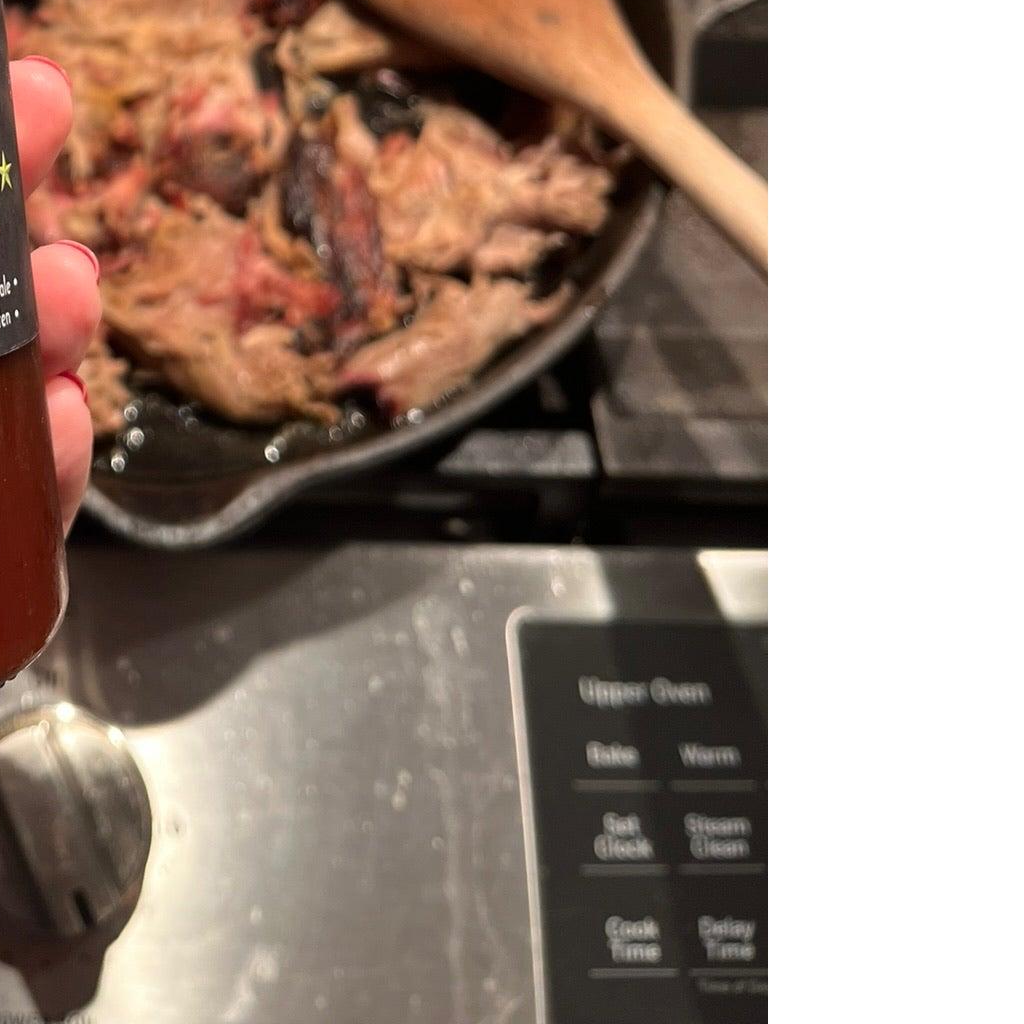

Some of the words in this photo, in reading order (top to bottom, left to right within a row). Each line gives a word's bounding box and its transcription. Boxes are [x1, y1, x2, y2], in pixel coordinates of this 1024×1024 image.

[578, 676, 649, 707] Upper
[649, 676, 712, 706] Oven
[586, 741, 640, 769] Bake
[678, 742, 741, 768] Warm
[603, 812, 640, 837] Set
[684, 812, 751, 837] Steam
[594, 833, 654, 860] Clock
[689, 834, 749, 860] Clean
[605, 915, 660, 941] Cook
[698, 915, 755, 942] Delay
[608, 940, 662, 963] Time
[705, 940, 755, 963] Time
